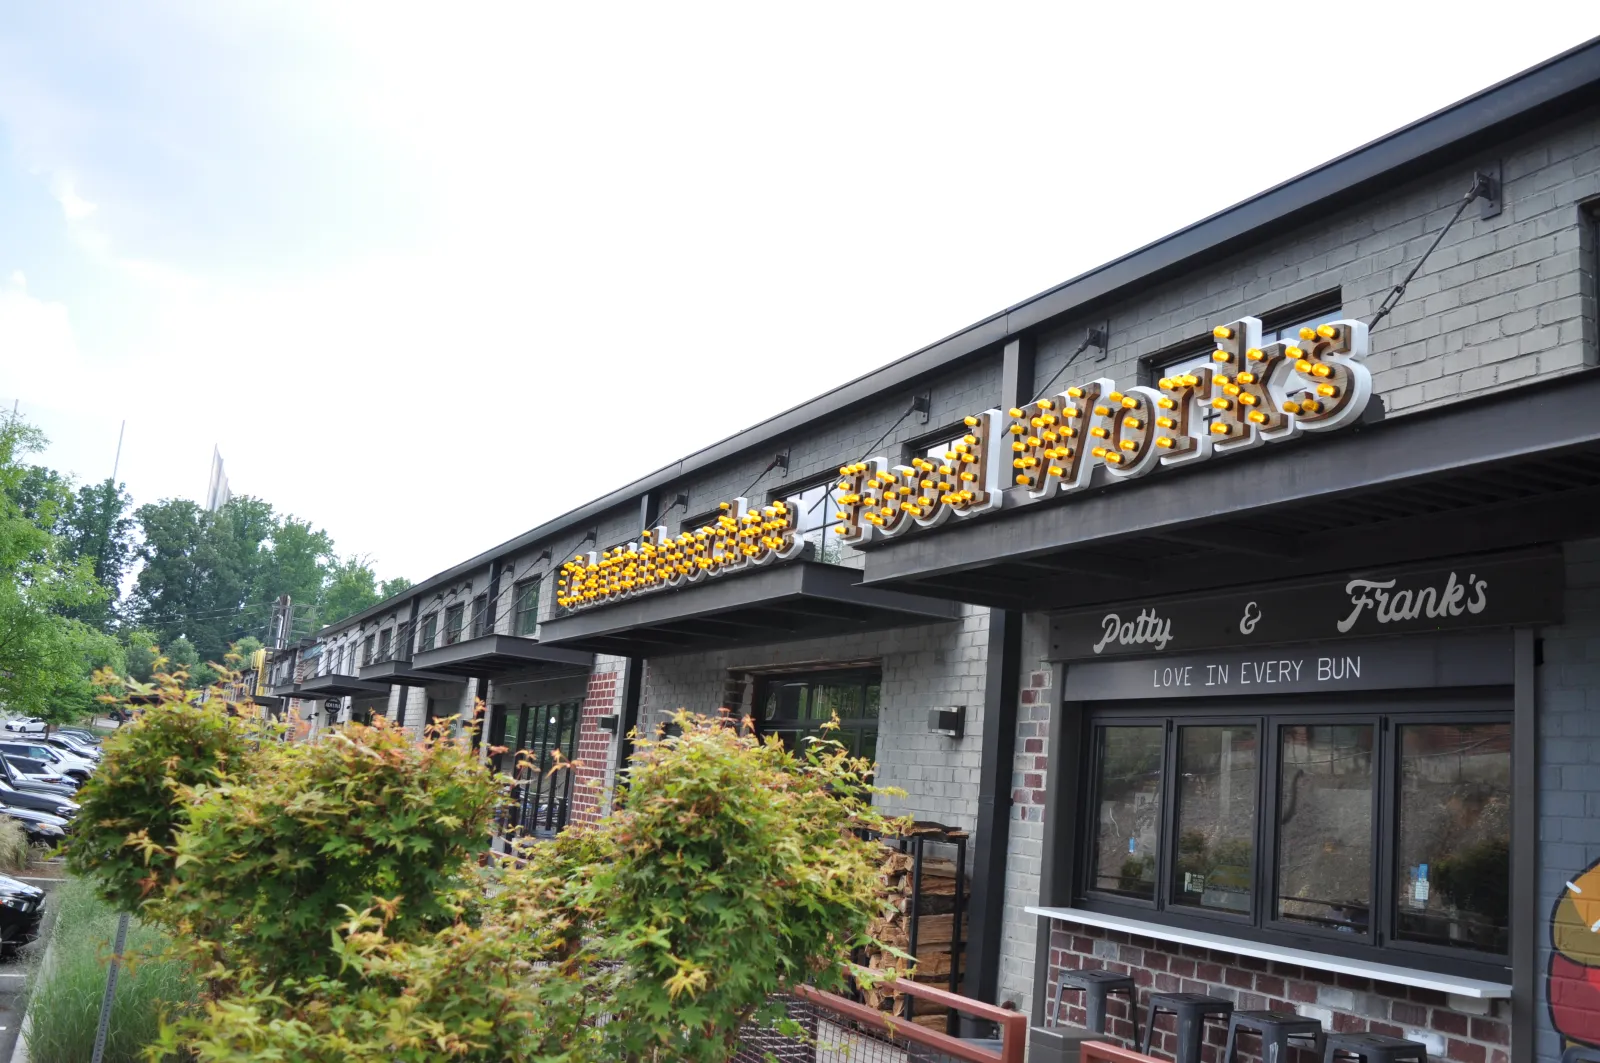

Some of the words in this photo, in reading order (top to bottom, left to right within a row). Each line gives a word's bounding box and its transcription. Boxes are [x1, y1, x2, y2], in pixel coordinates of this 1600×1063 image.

[835, 409, 1002, 545] Food
[1009, 316, 1373, 499] Works
[1093, 608, 1173, 654] Patty
[1239, 602, 1262, 635] &
[1337, 572, 1487, 633] Frank's
[1153, 666, 1192, 687] LOVE
[1205, 664, 1229, 686] IN
[1240, 660, 1303, 684] EVERY
[1317, 656, 1361, 680] BUN
